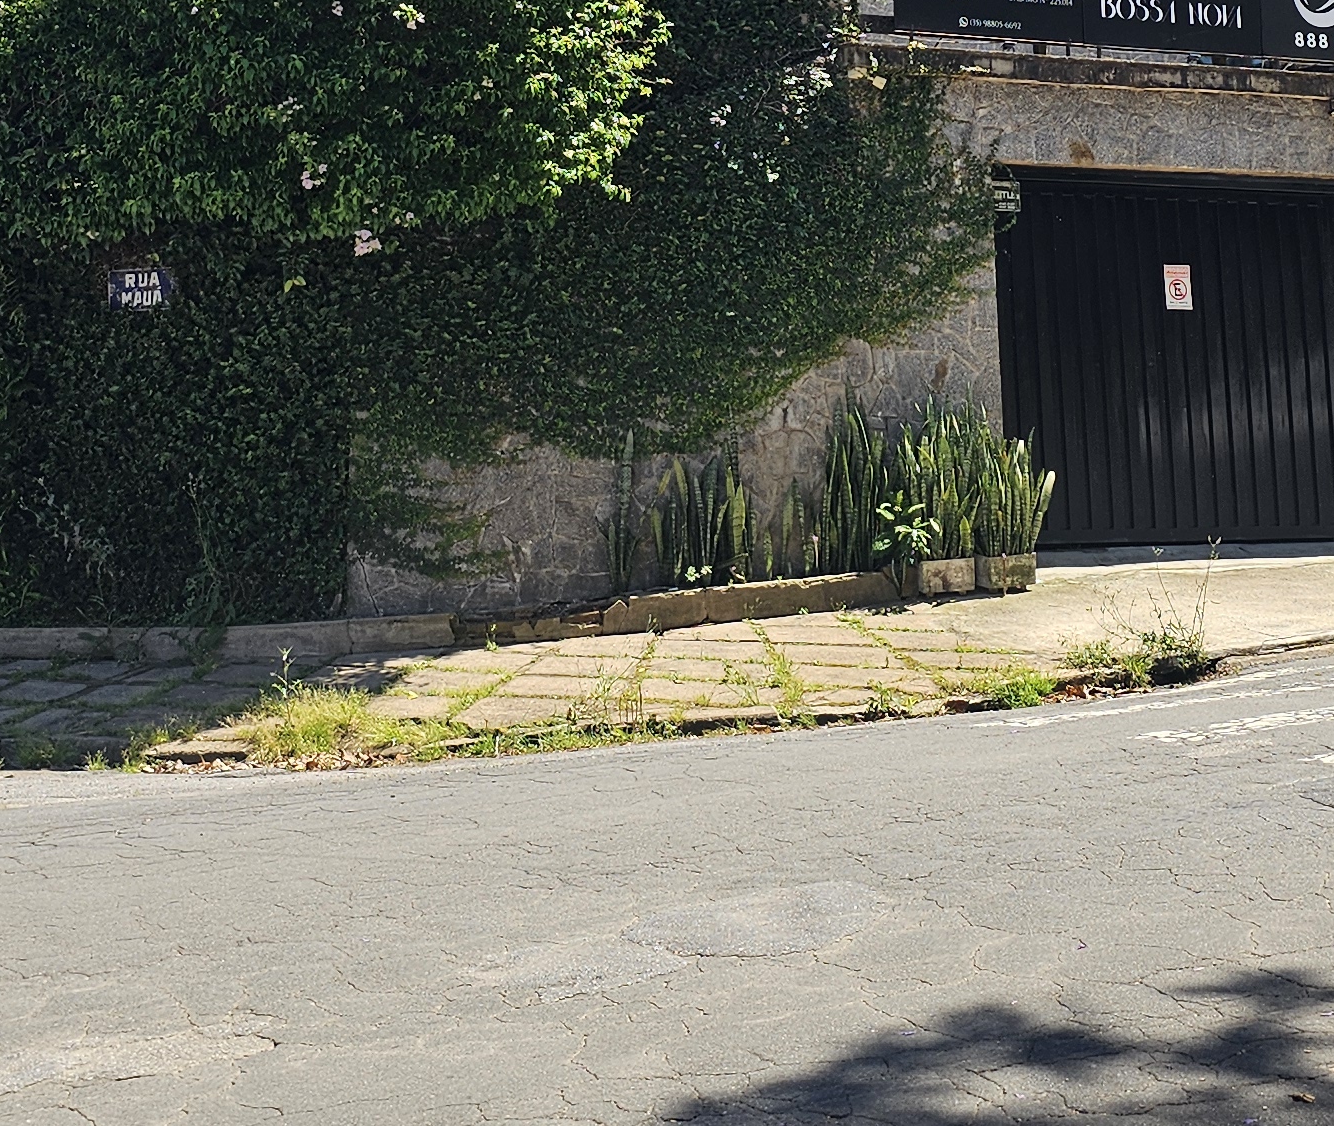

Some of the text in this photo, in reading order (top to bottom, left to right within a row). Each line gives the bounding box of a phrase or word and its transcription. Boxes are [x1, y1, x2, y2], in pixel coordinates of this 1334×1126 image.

[1188, 1, 1242, 29] NOVA
[1294, 31, 1330, 50] 888
[125, 271, 160, 288] RUA
